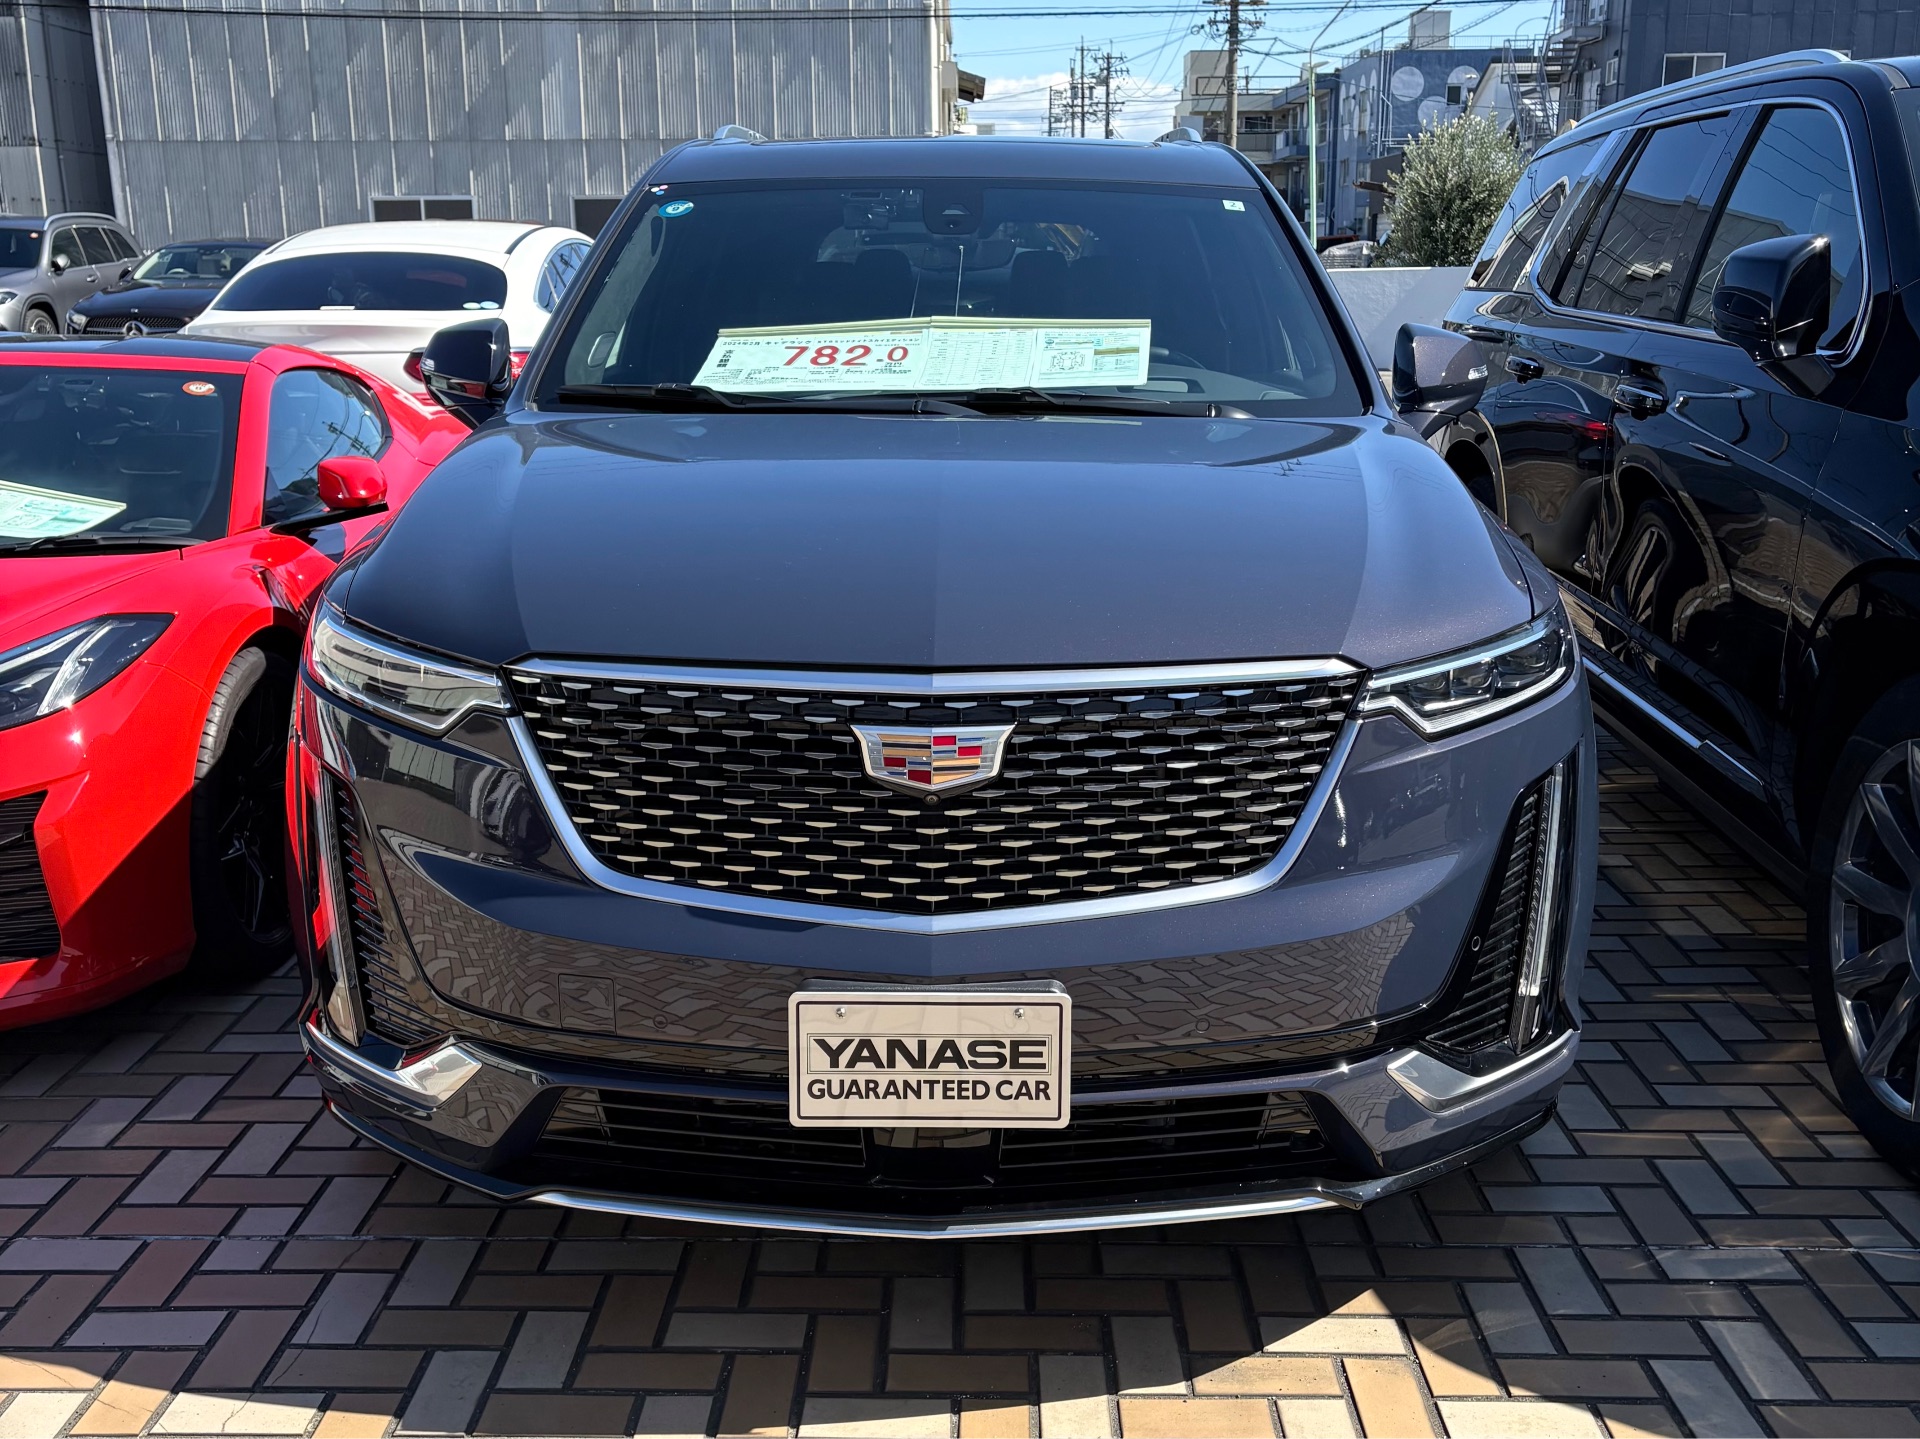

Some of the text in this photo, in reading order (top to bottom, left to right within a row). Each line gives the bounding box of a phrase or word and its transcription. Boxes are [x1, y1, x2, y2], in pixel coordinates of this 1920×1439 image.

[783, 345, 909, 366] 782.0
[813, 1039, 1047, 1070] YANASE
[807, 1079, 1051, 1101] GUARANTEED CAR
